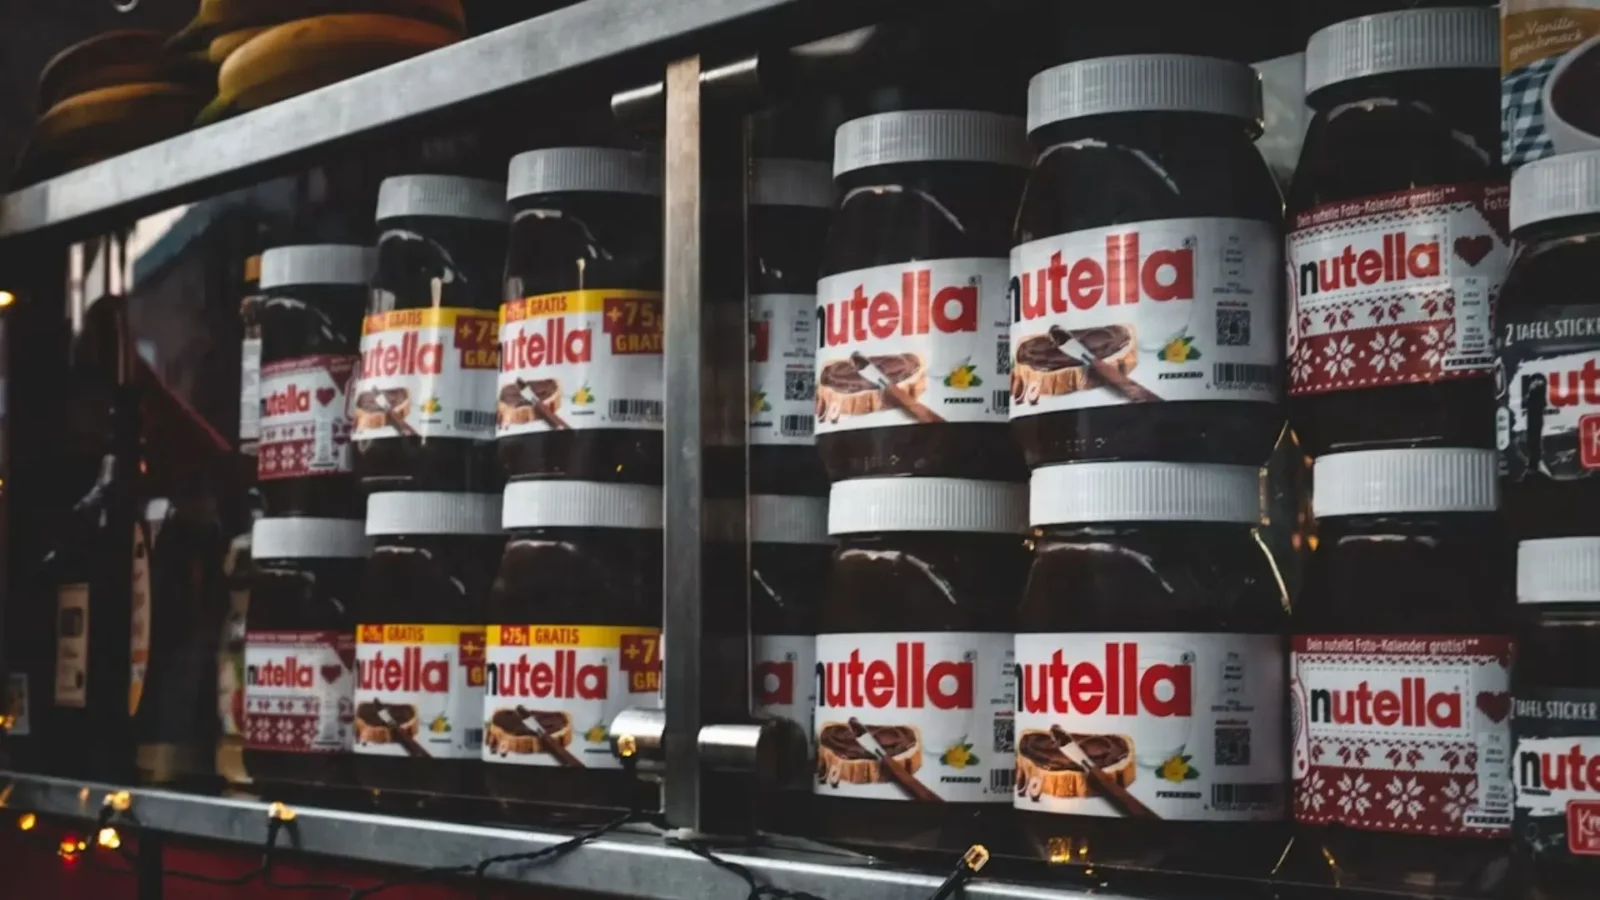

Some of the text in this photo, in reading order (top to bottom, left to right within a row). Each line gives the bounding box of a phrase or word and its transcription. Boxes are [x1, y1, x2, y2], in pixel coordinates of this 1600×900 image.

[1300, 232, 1440, 296] nutella
[530, 296, 567, 315] GRATIS
[1505, 323, 1513, 346] 2
[361, 331, 443, 380] utella
[1158, 371, 1204, 380] FERRERO
[535, 628, 580, 644] GRATIS
[248, 656, 313, 688] nutella
[486, 650, 607, 699] nutella
[1311, 677, 1461, 728] nutella
[1156, 790, 1202, 799] FERRERO
